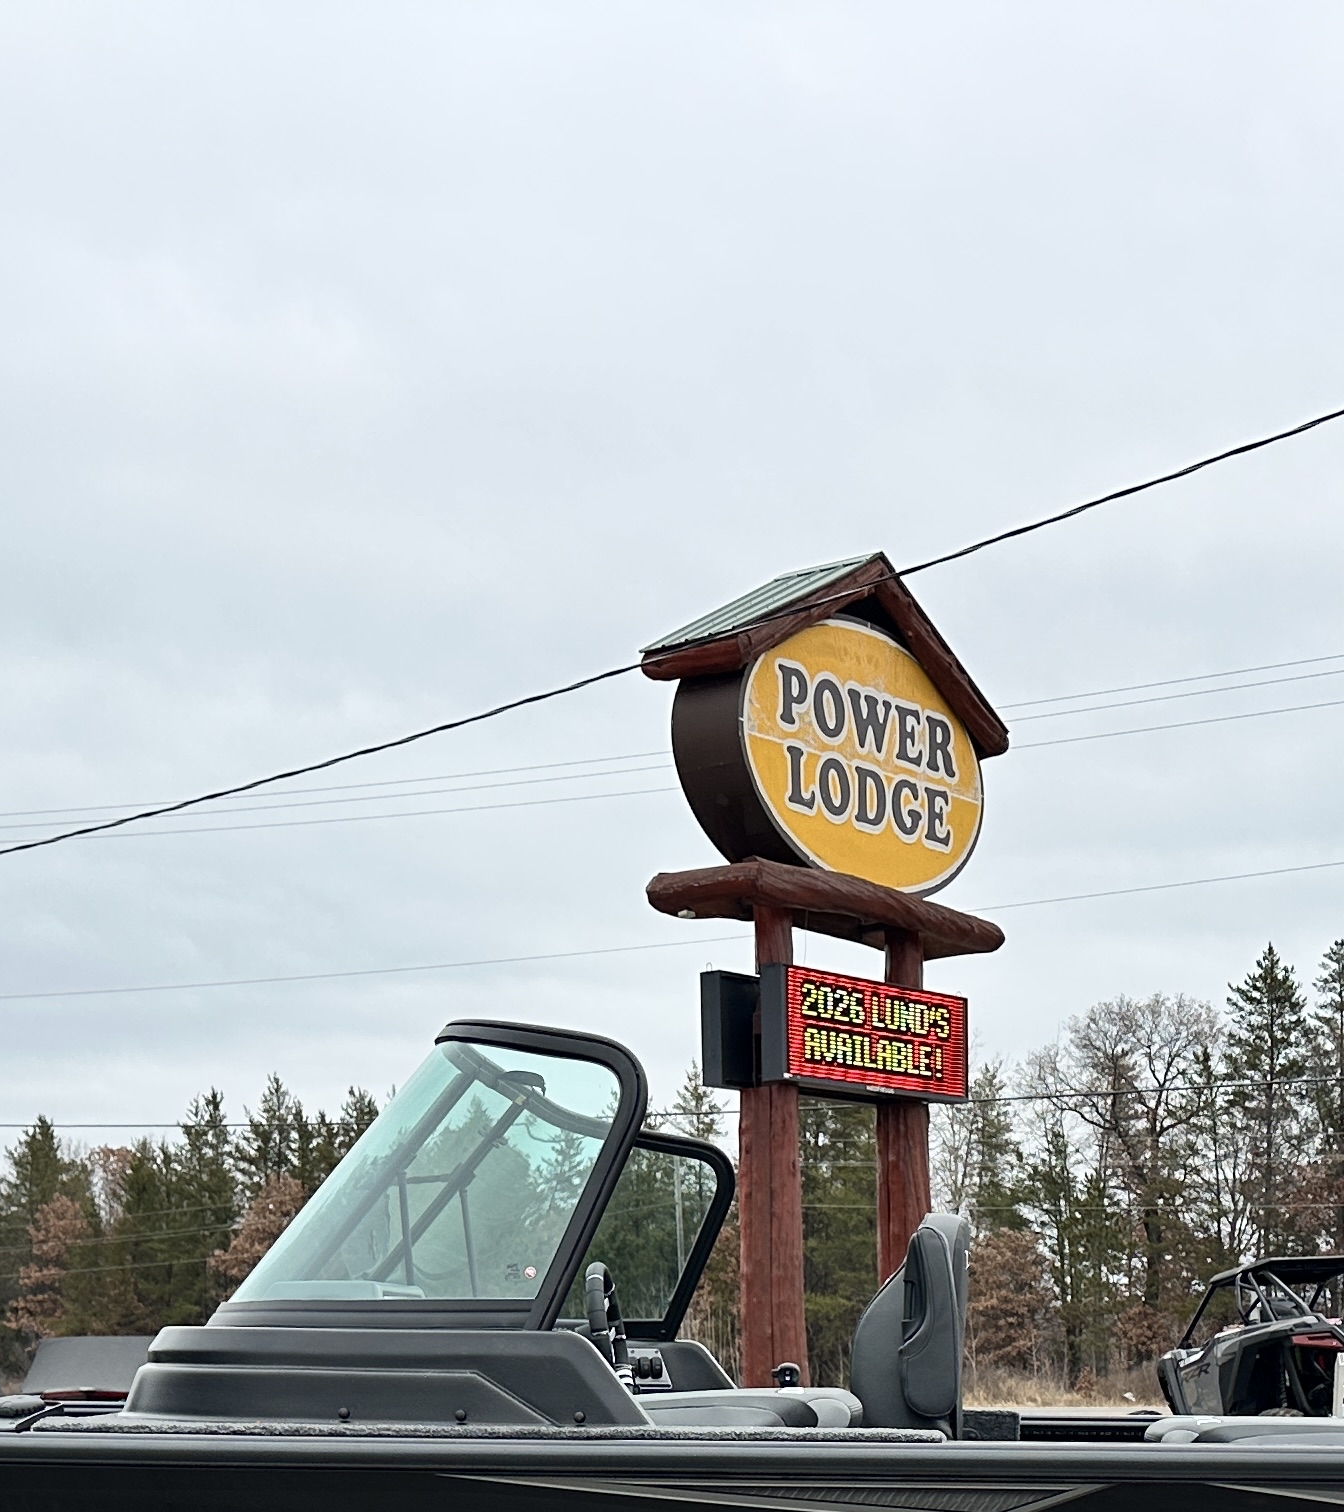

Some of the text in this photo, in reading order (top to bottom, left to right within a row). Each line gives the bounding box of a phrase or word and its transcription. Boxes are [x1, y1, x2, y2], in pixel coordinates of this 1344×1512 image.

[778, 663, 956, 778] POWER
[786, 745, 951, 847] LODGE
[801, 983, 950, 1038] 2026 LUND'S
[804, 1028, 943, 1078] AVAILABLE!
